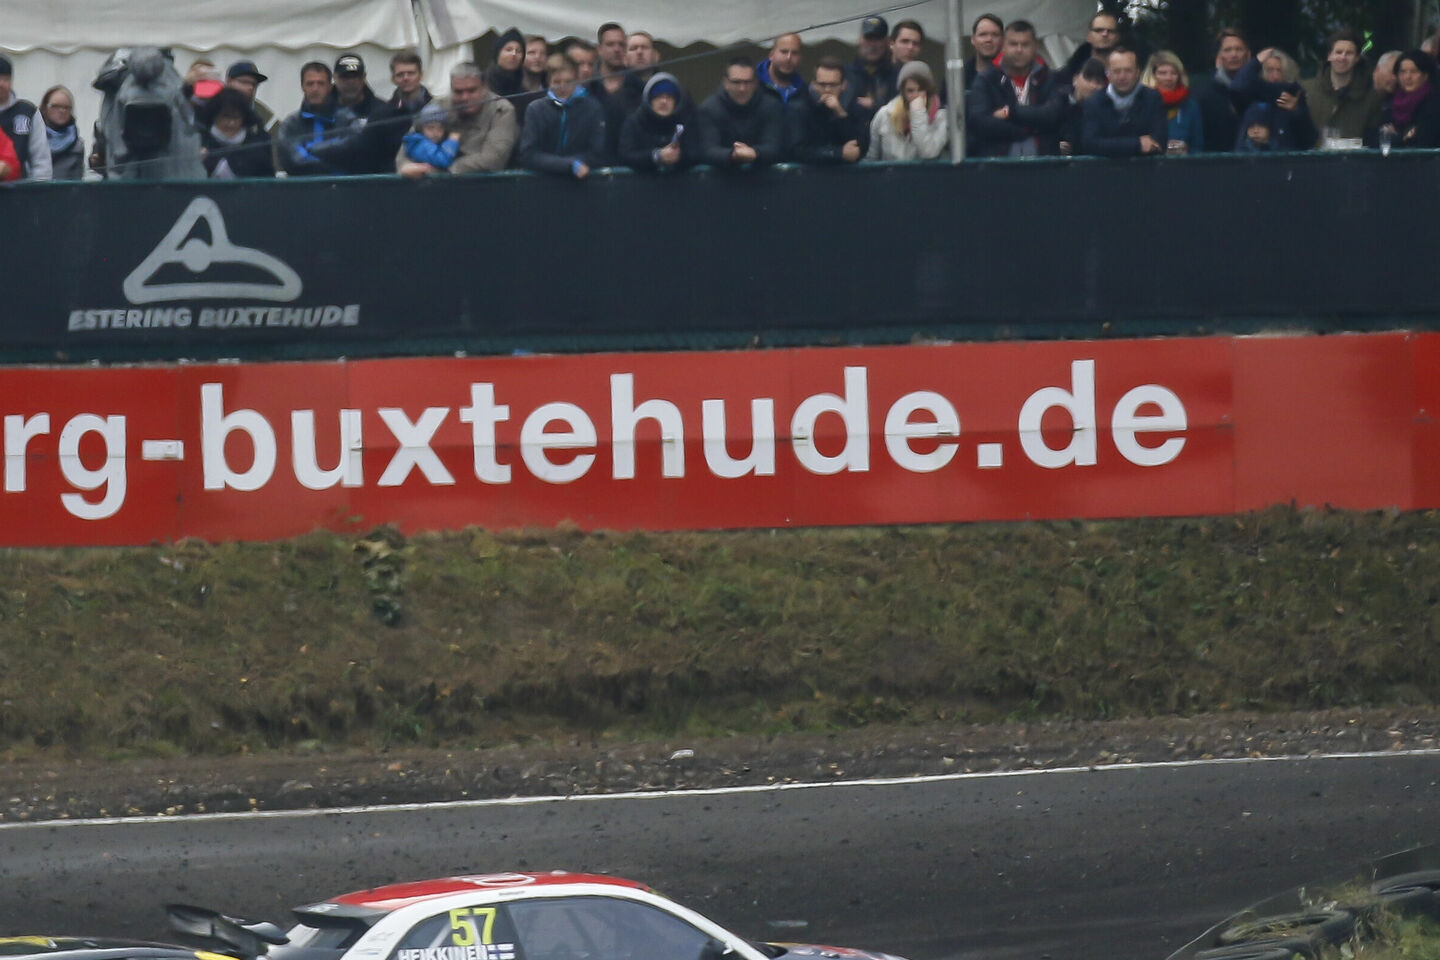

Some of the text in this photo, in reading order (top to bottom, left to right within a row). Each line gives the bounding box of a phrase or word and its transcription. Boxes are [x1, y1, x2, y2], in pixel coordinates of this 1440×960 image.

[67, 303, 360, 332] ESTERING BUXTEHUDE
[449, 907, 497, 946] 57
